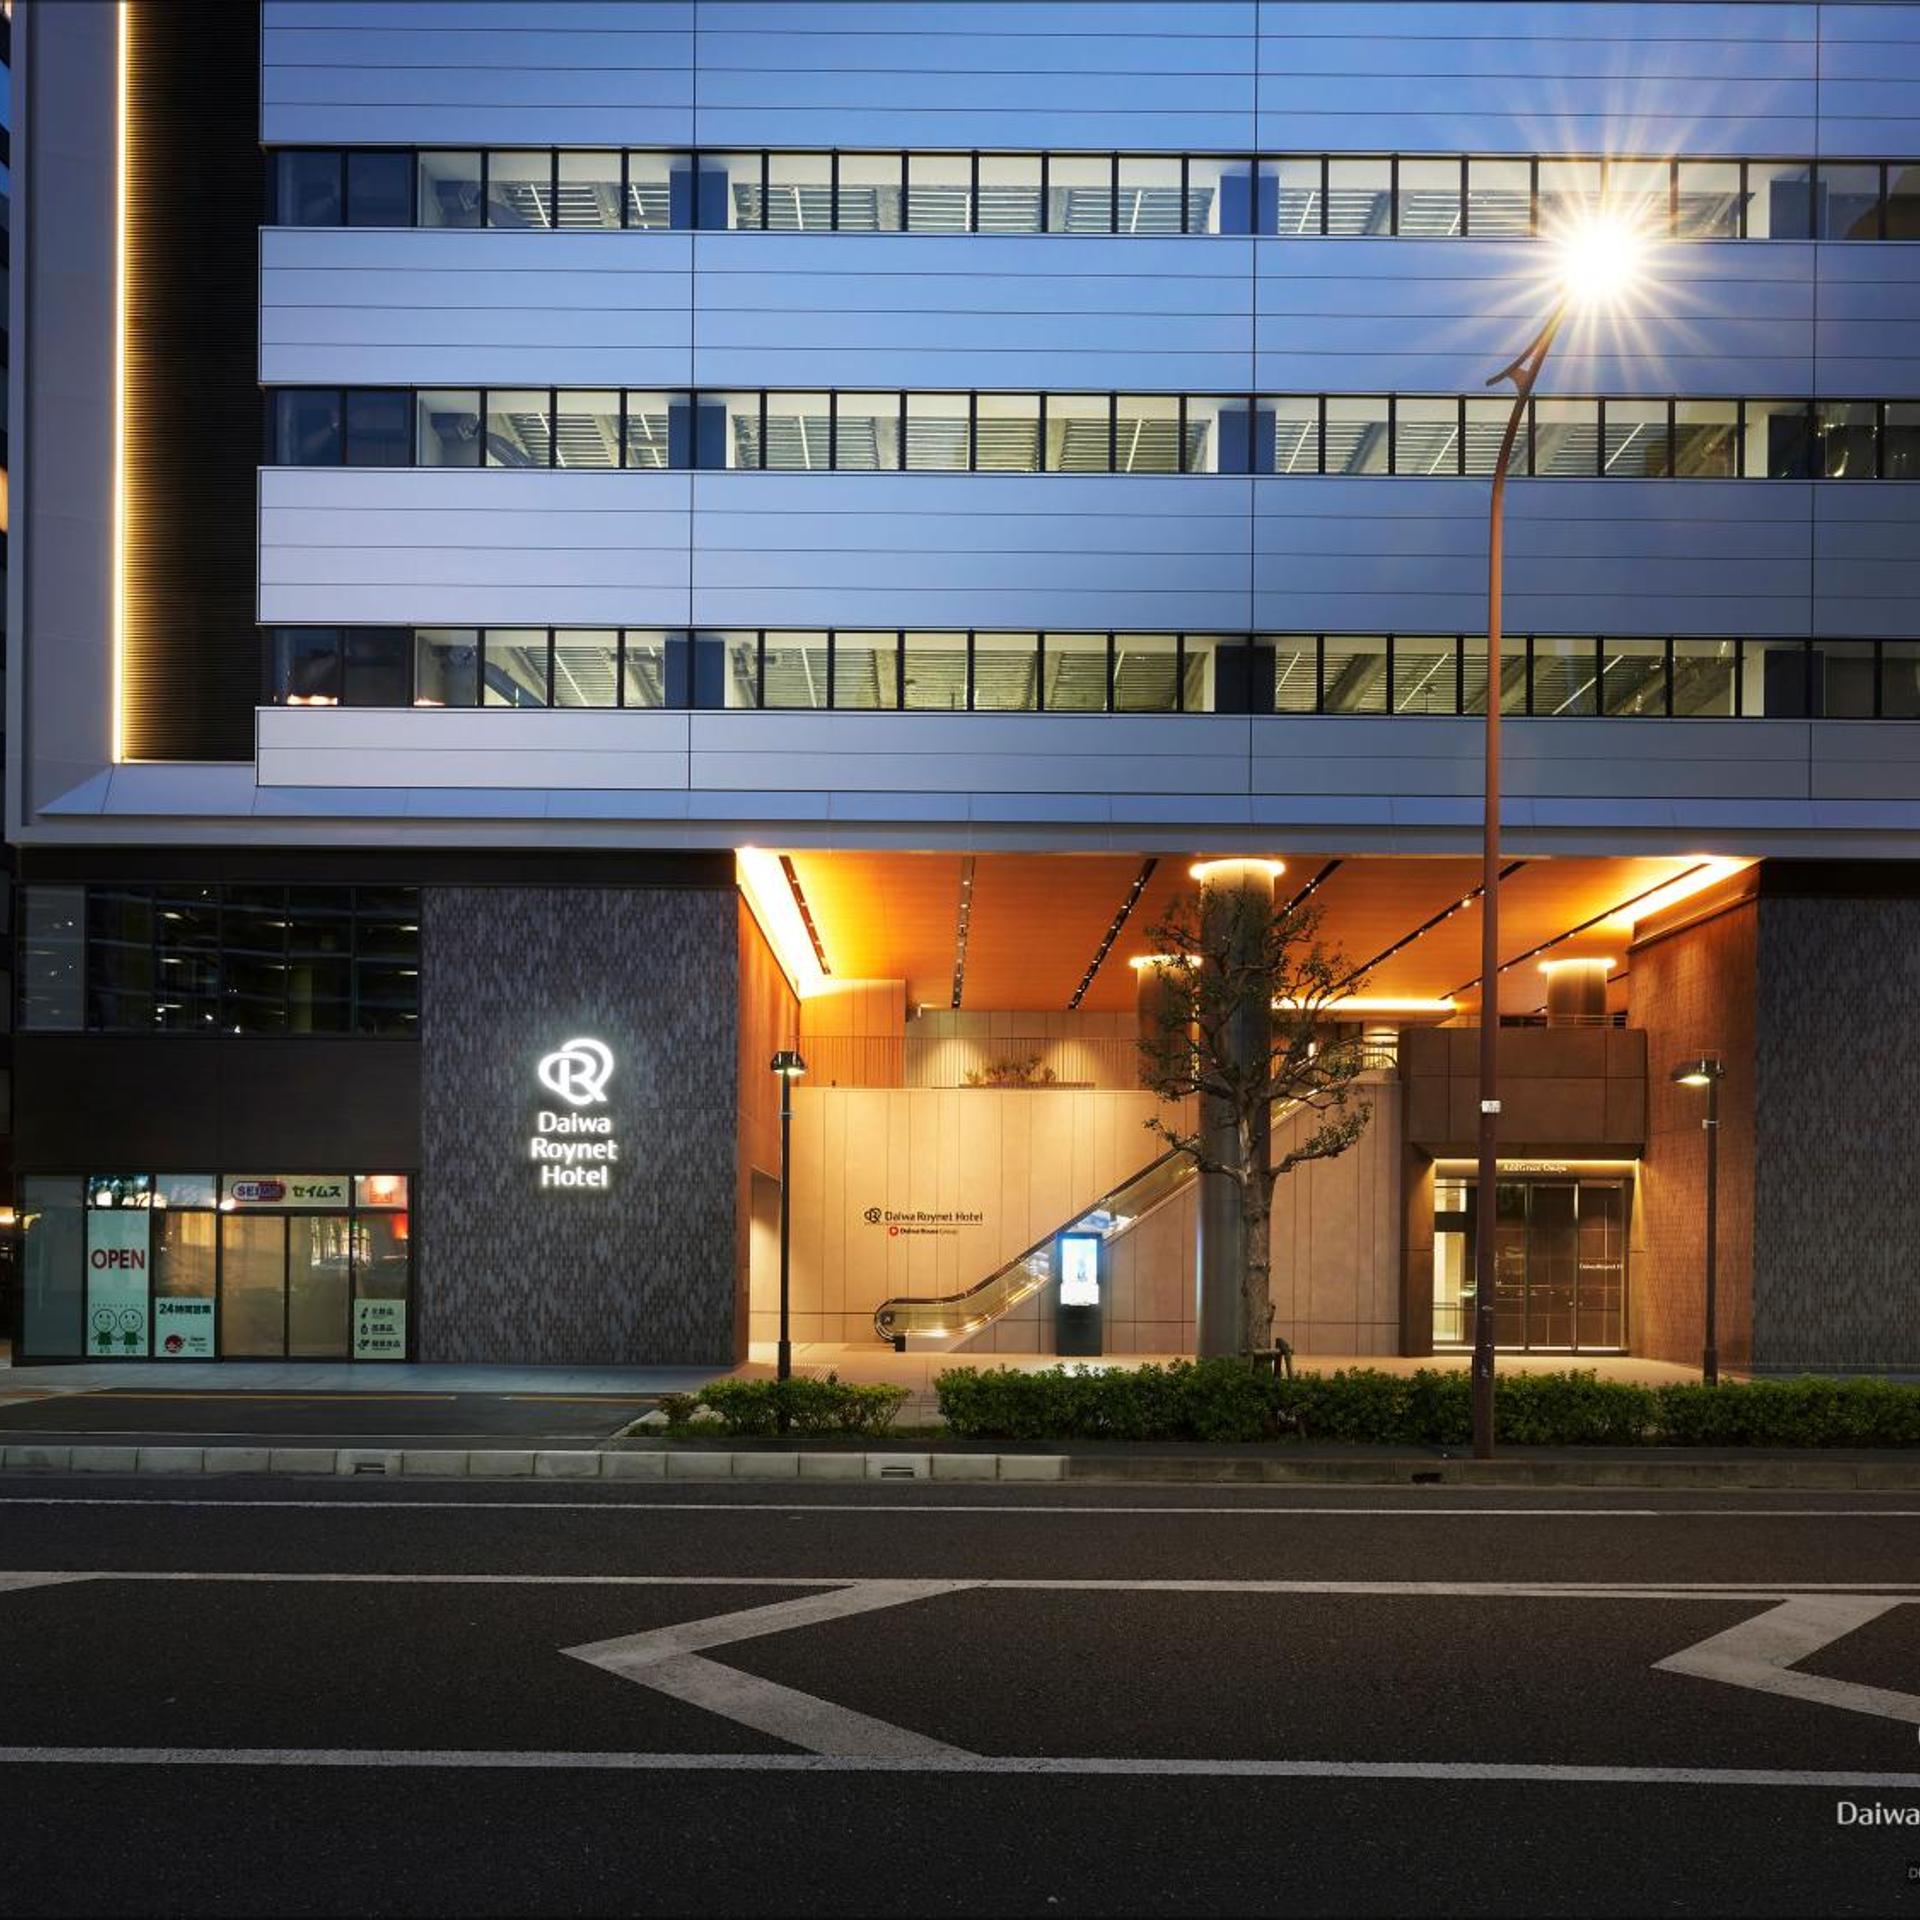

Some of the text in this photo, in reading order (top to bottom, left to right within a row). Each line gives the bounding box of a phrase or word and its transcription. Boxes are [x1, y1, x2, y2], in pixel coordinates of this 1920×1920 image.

[538, 1111, 612, 1133] Daiwa
[531, 1138, 618, 1164] Roynet
[542, 1165, 609, 1188] Hotel
[292, 1185, 341, 1198] セイムス
[884, 1211, 983, 1224] Daiwa Roynet Hotel
[91, 1249, 145, 1269] OPEN
